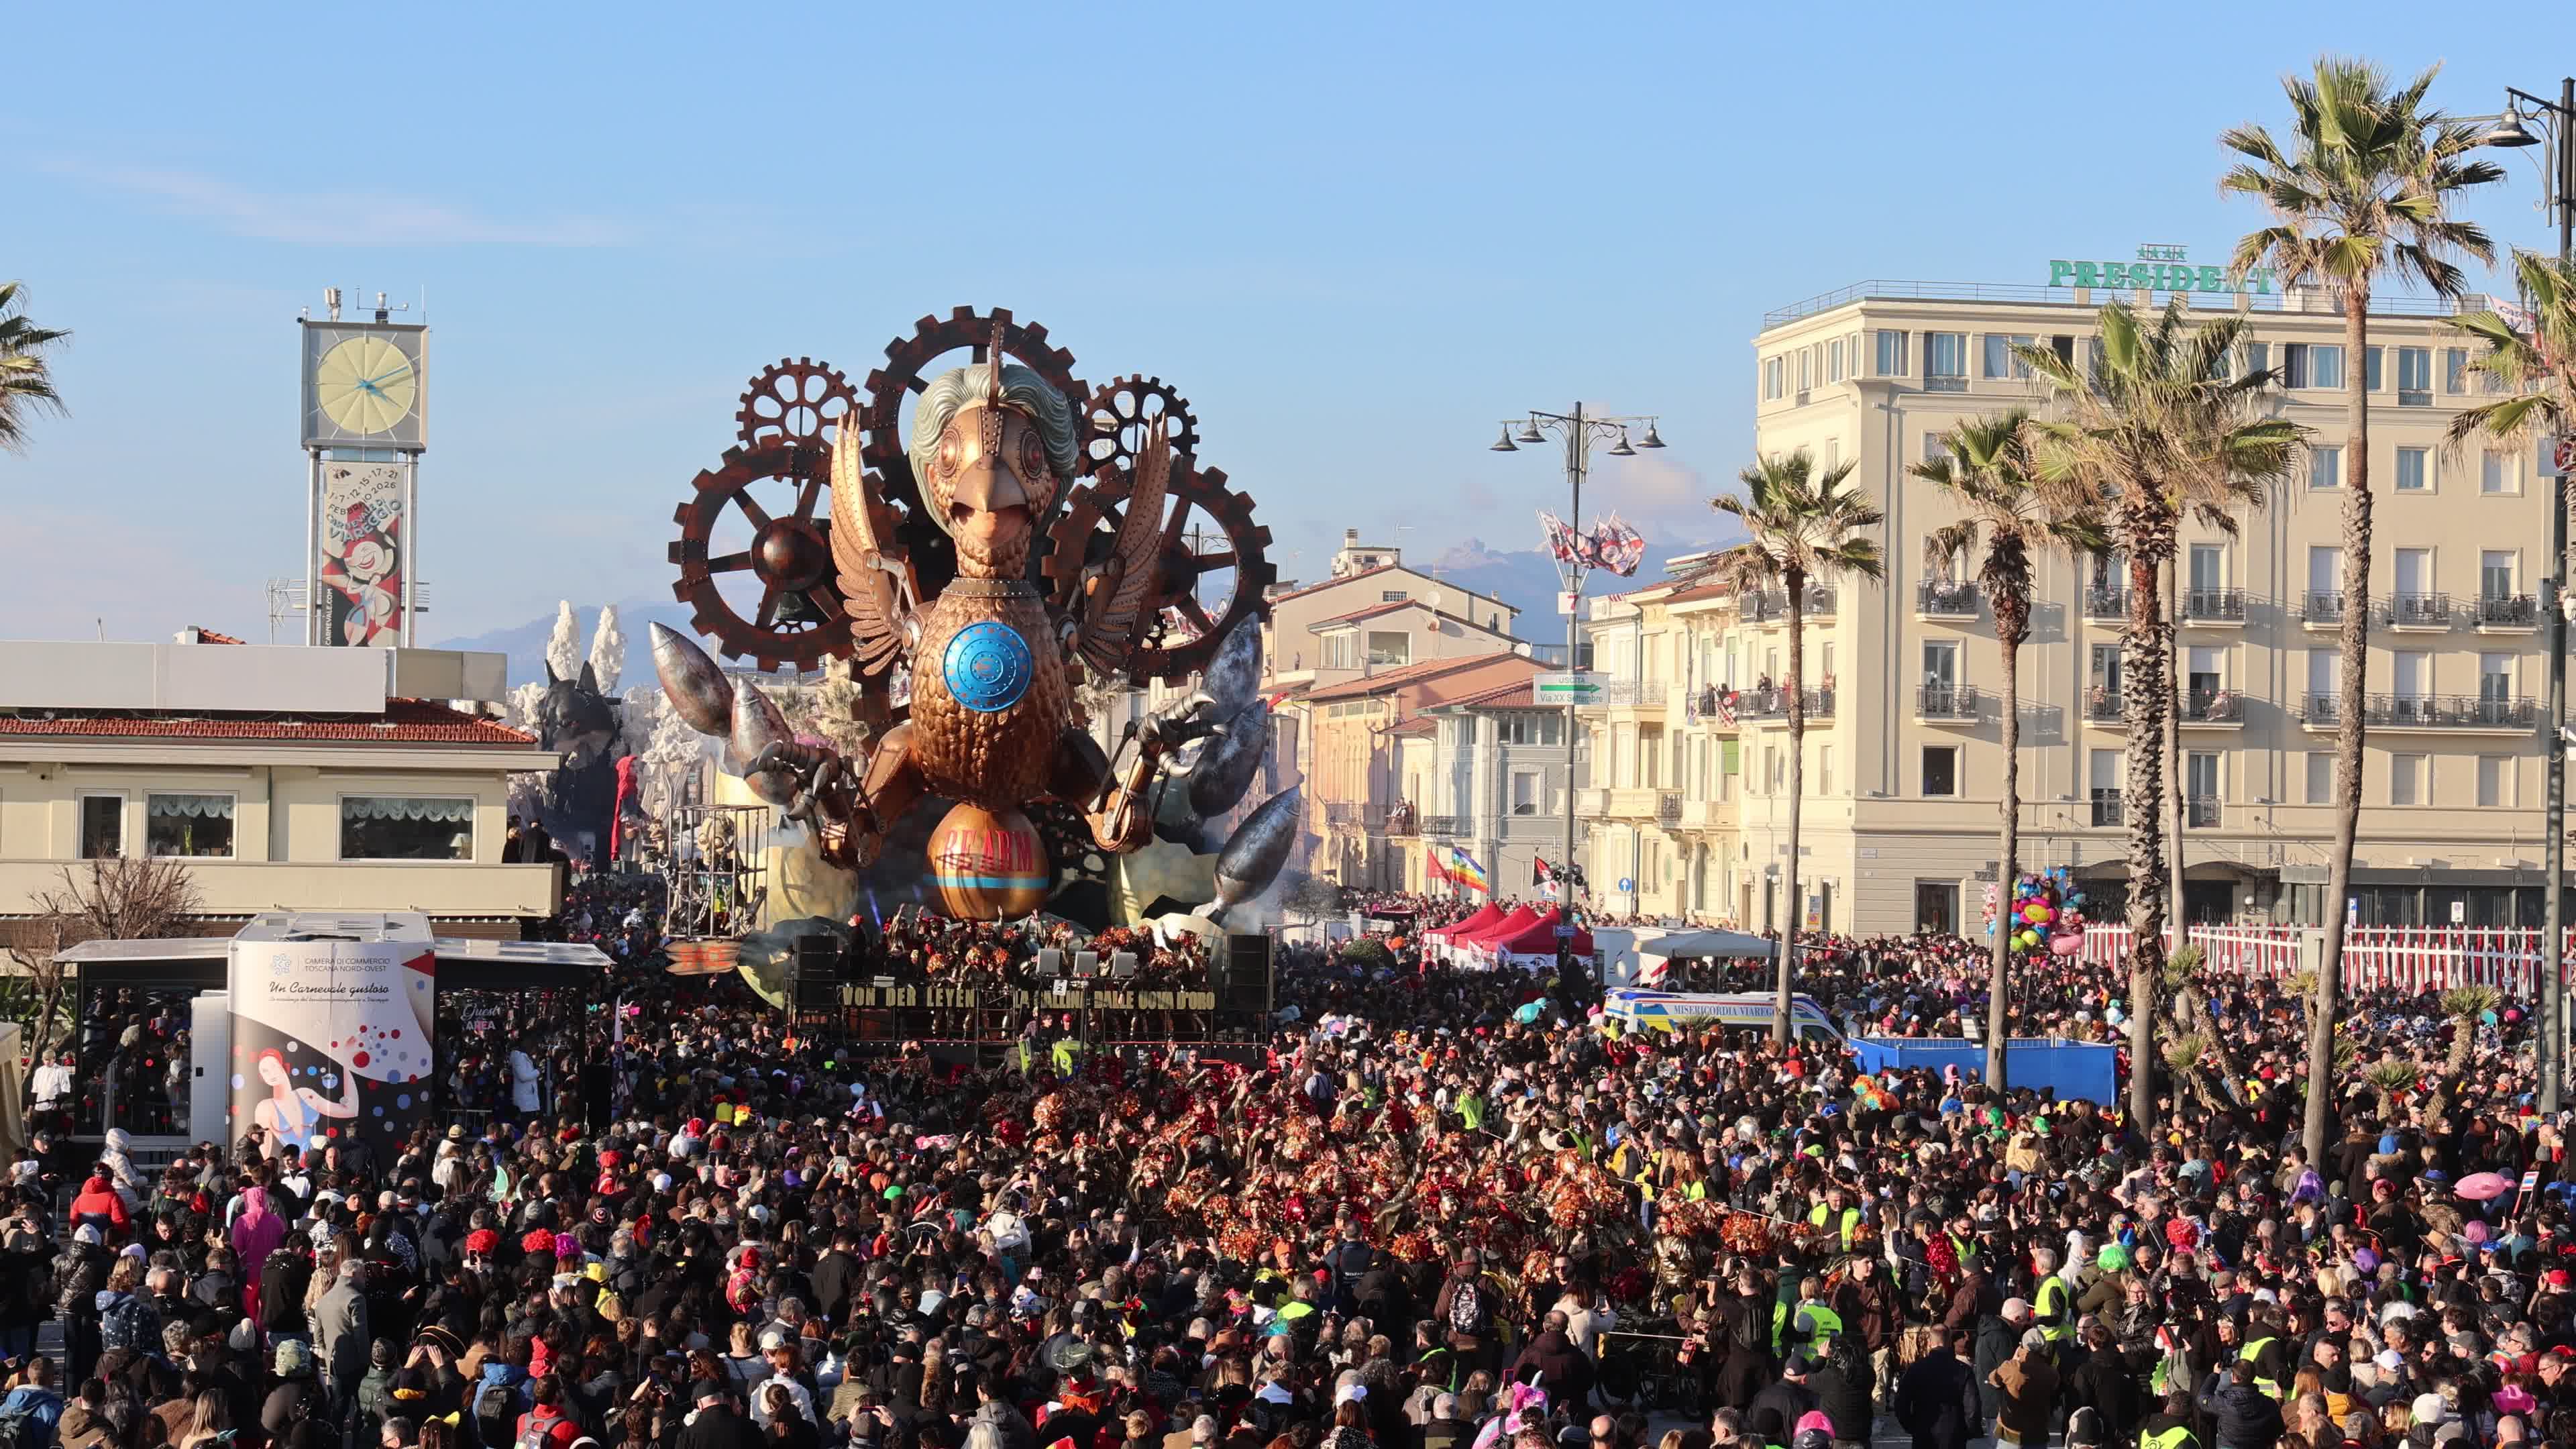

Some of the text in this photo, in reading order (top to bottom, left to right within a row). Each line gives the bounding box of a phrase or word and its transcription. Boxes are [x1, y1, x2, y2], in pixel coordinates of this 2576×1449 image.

[2049, 260, 2275, 294] PRESIDET
[371, 481, 396, 494] 2026
[329, 499, 402, 543] VIAREGGIO
[1567, 594, 1579, 610] 7
[1558, 676, 1586, 684] USCITA
[1540, 693, 1603, 703] Via XX Settembre
[305, 957, 390, 965] CAMERA DI COMMERCIO
[269, 981, 389, 998] Un Carnevale gustoso
[843, 987, 875, 1006] VON
[885, 987, 917, 1007] DER
[926, 987, 975, 1008] LEYEN
[1093, 990, 1134, 1010] DALLE
[1176, 991, 1216, 1011] D'ORO
[1674, 1004, 1738, 1016] MISERICORDIA
[466, 1020, 496, 1031] AREA
